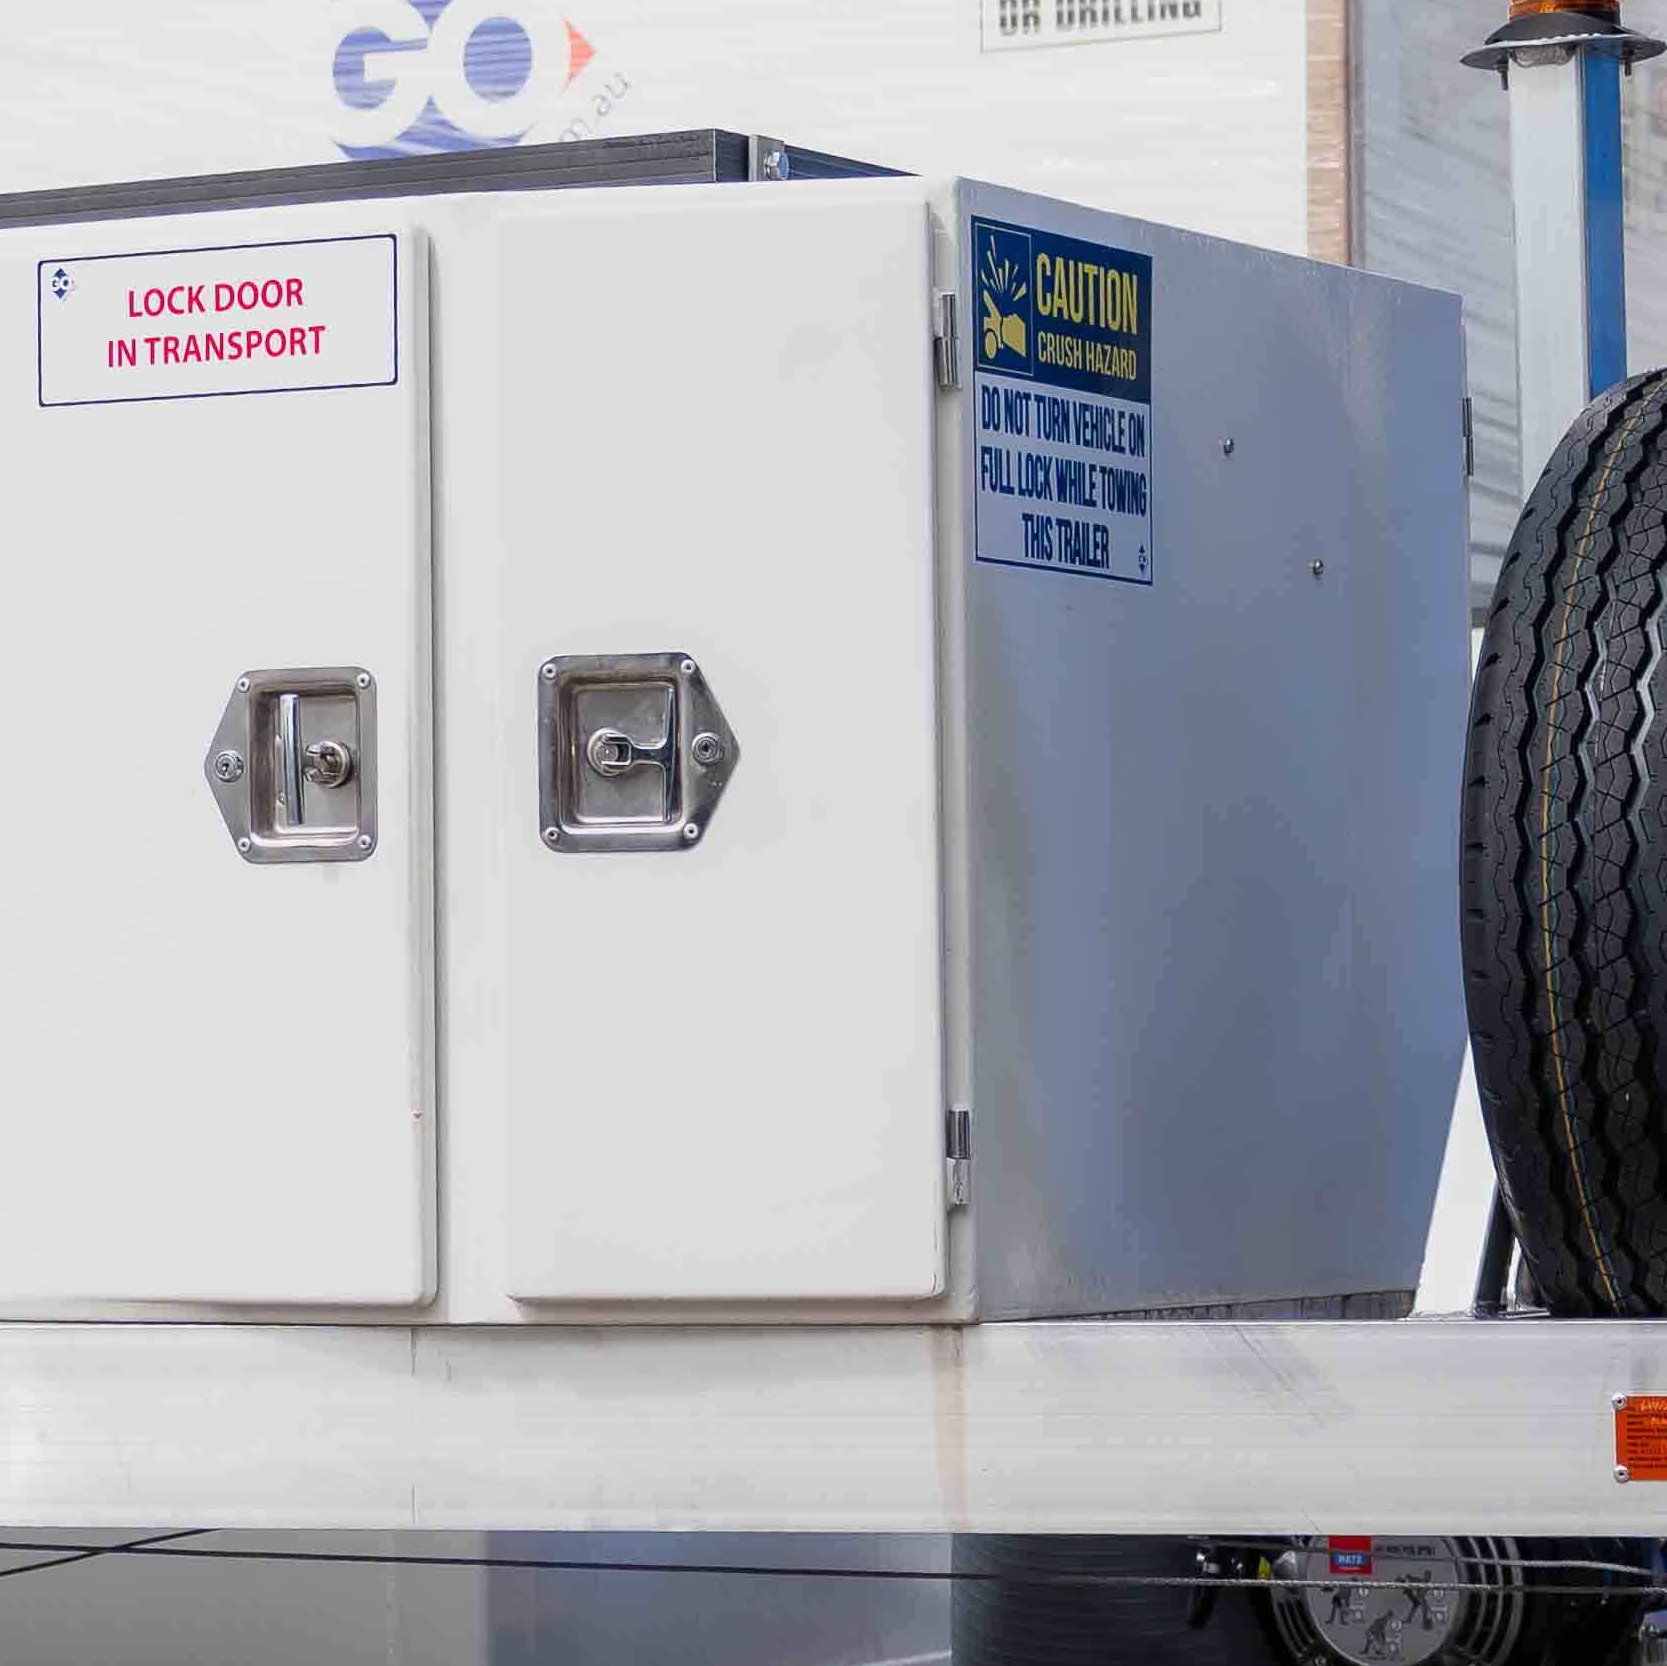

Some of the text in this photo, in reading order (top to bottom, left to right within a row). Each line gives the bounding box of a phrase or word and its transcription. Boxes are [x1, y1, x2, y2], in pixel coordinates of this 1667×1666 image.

[128, 278, 304, 318] LOCK DOOR
[1036, 252, 1138, 335] CAUTION
[108, 325, 326, 368] IN TRANSPORT
[1038, 330, 1137, 381] CRUSH HAZARD
[982, 385, 1145, 457] DO NOT TURN VEHICLE ON
[981, 446, 1147, 517] FULL LOCK WHILE TOWING
[1022, 513, 1109, 570] THIS TRAILER
